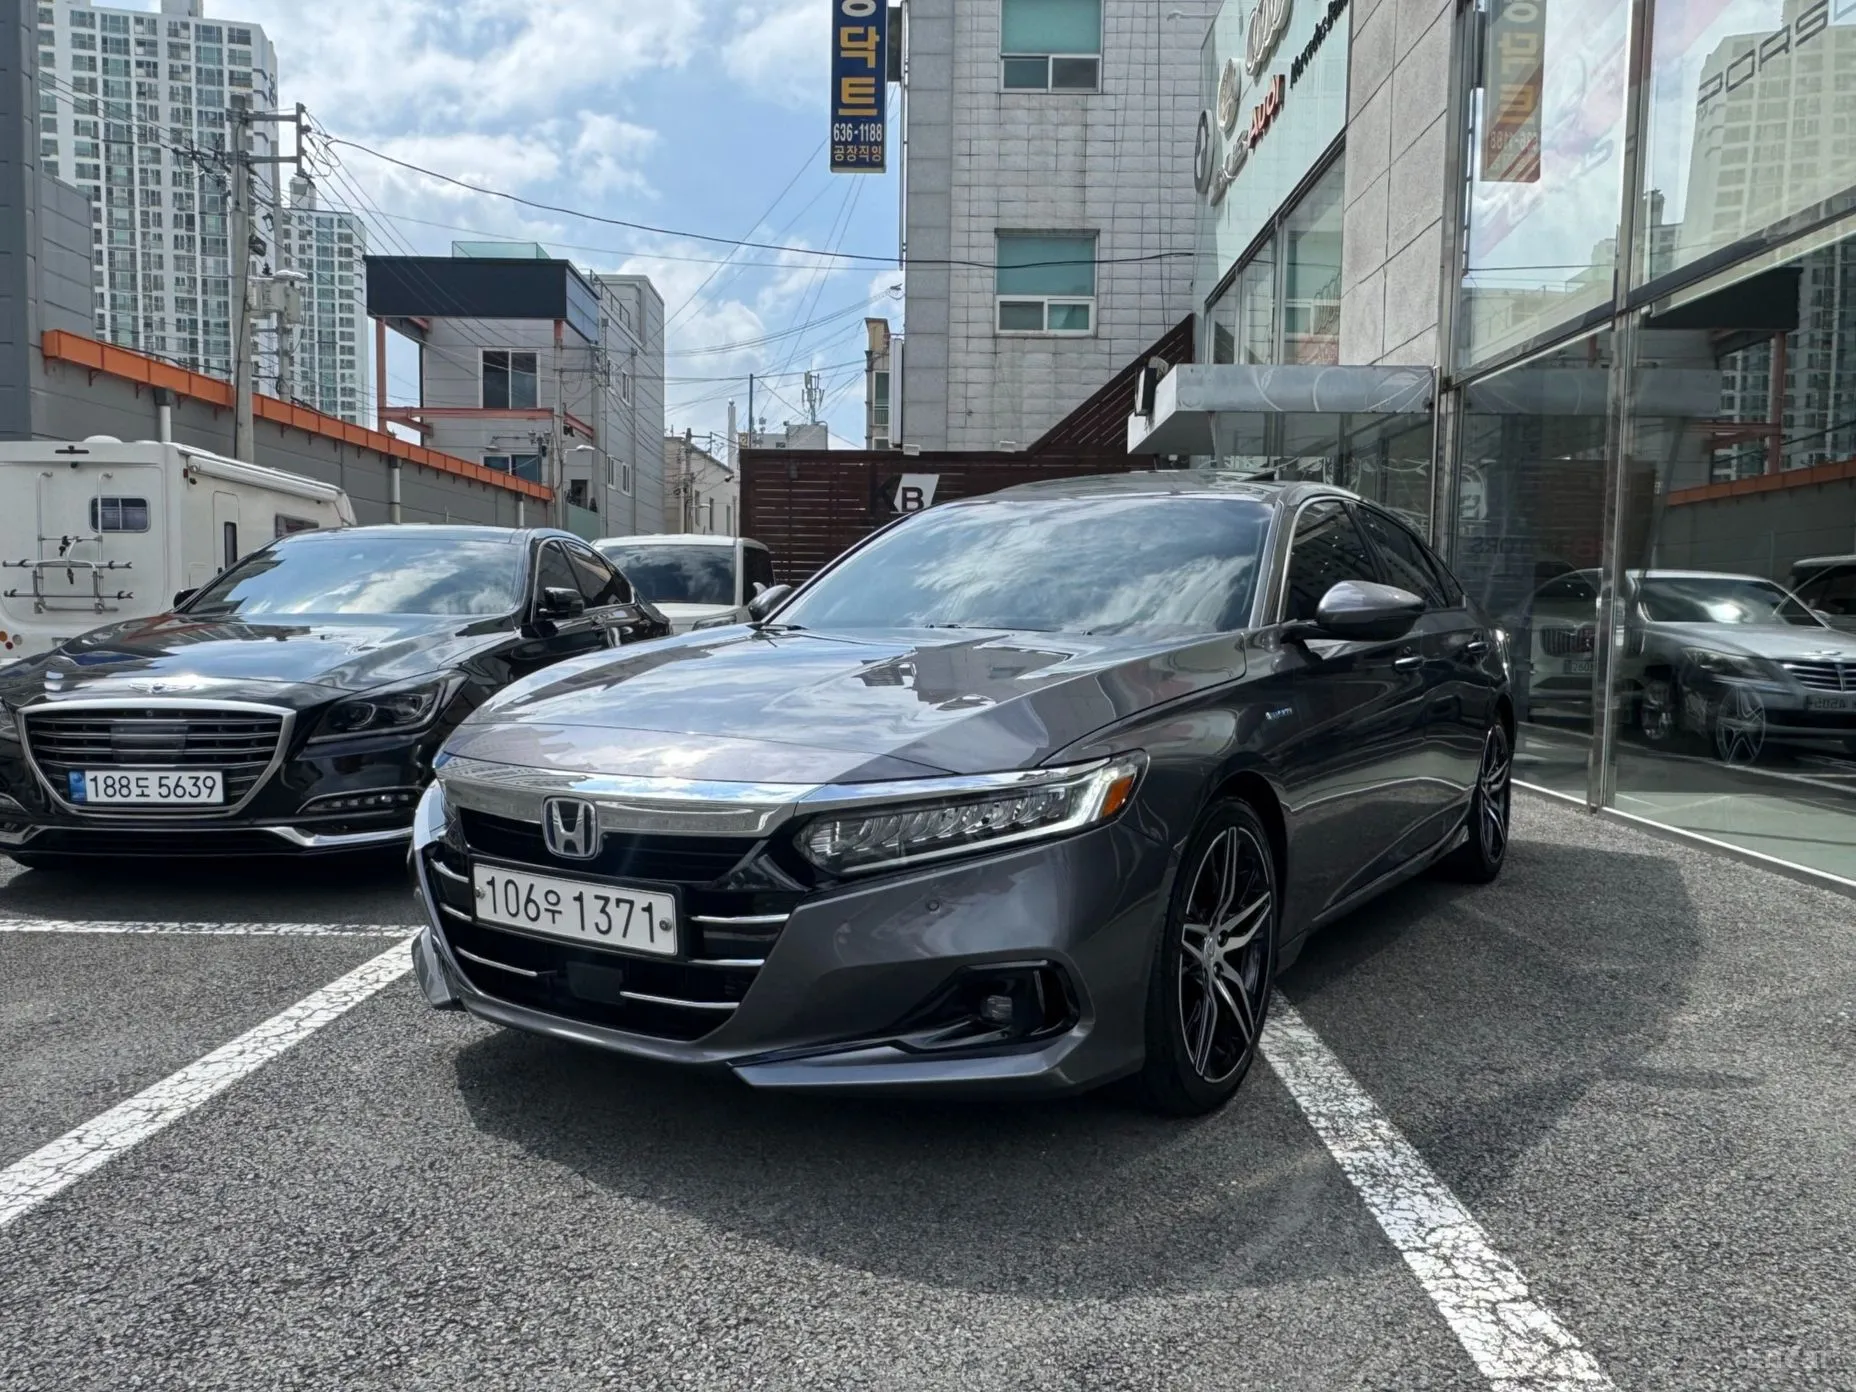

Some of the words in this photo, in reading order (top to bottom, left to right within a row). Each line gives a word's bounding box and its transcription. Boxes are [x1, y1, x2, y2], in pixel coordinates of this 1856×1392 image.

[833, 123, 882, 142] 636-1188
[90, 775, 150, 798] 188도
[158, 775, 216, 799] 5639
[486, 876, 562, 925] 106우
[573, 890, 655, 943] 1371
